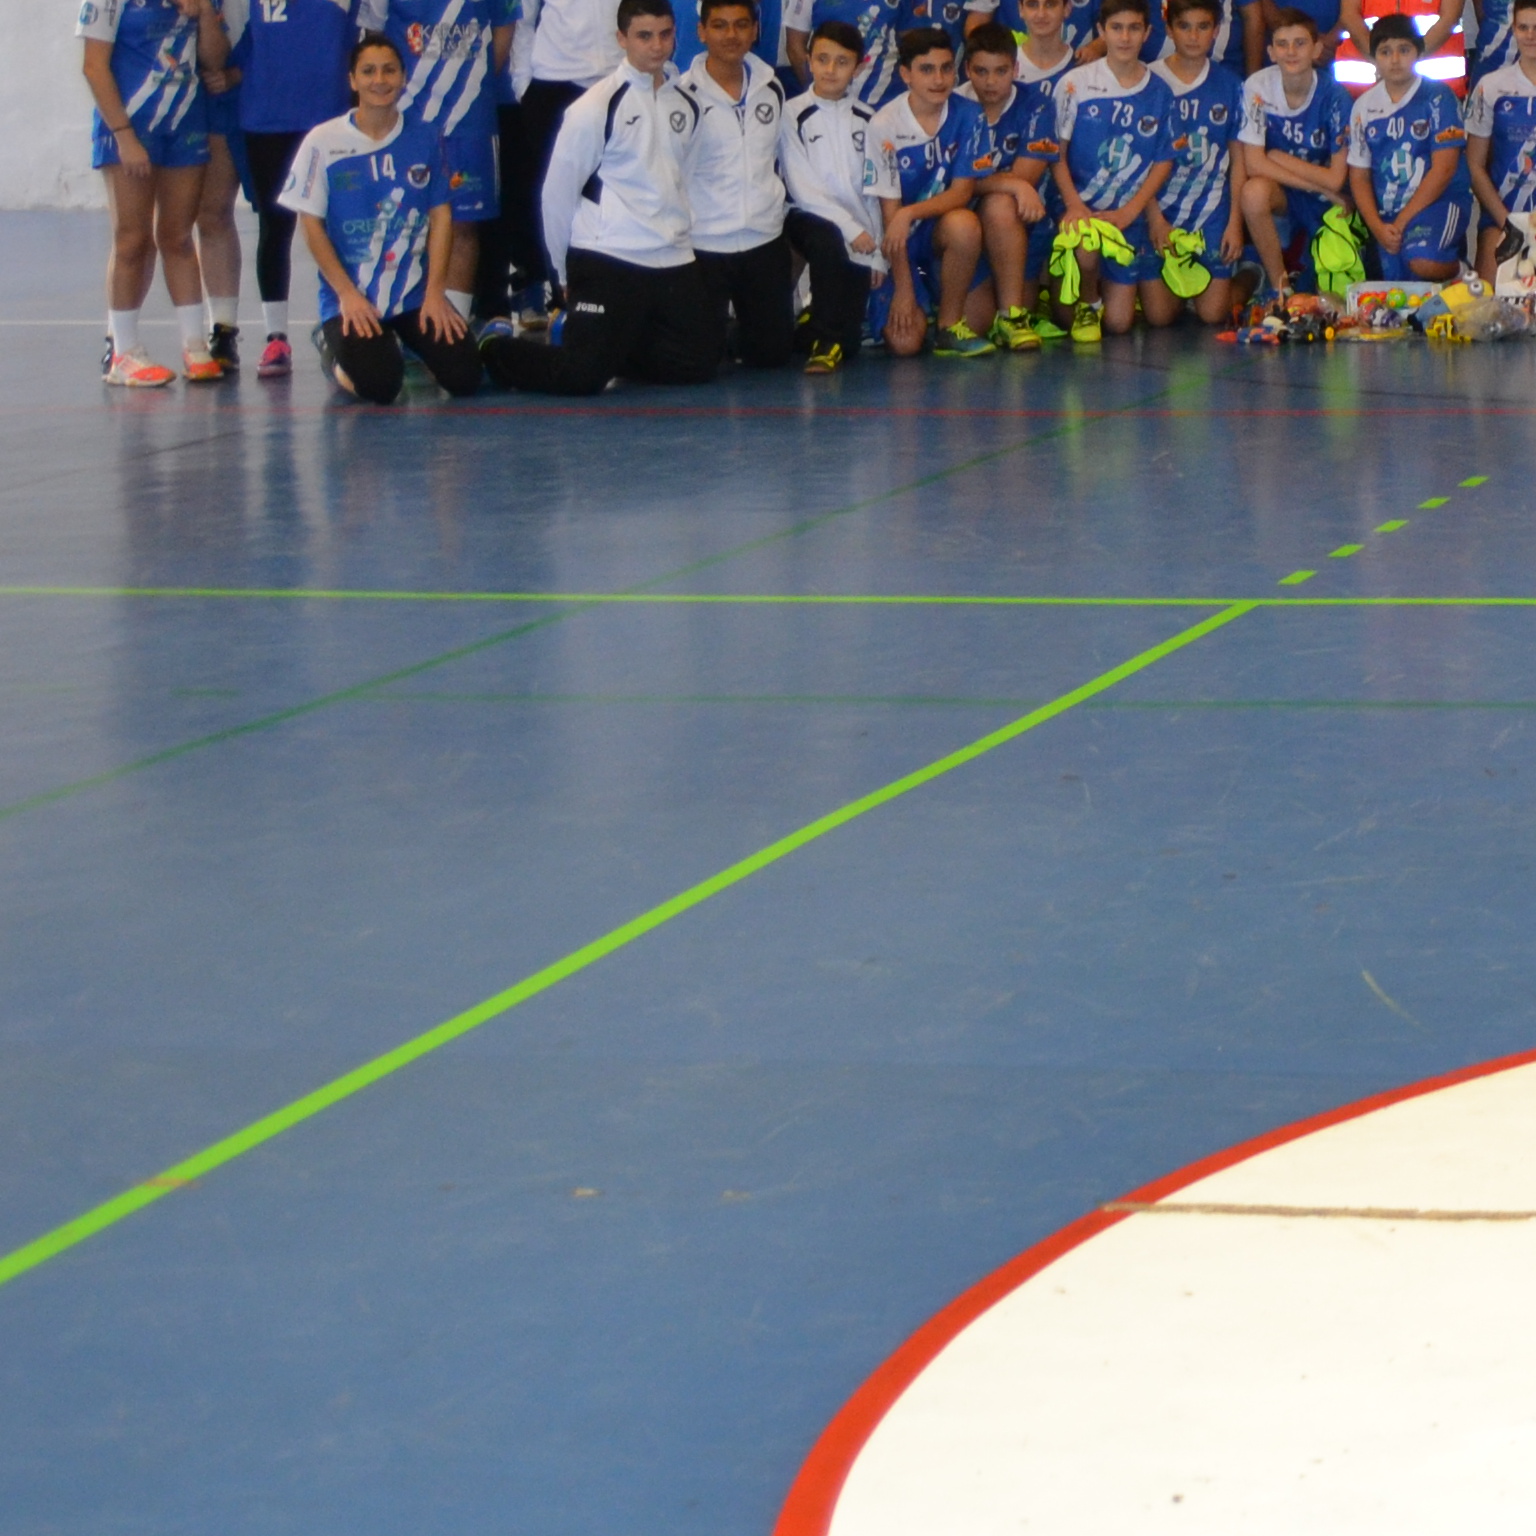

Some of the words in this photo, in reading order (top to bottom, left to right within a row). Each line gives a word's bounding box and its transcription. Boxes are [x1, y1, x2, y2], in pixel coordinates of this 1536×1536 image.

[1111, 99, 1135, 127] 73
[1178, 97, 1200, 122] 97
[370, 154, 396, 182] 14
